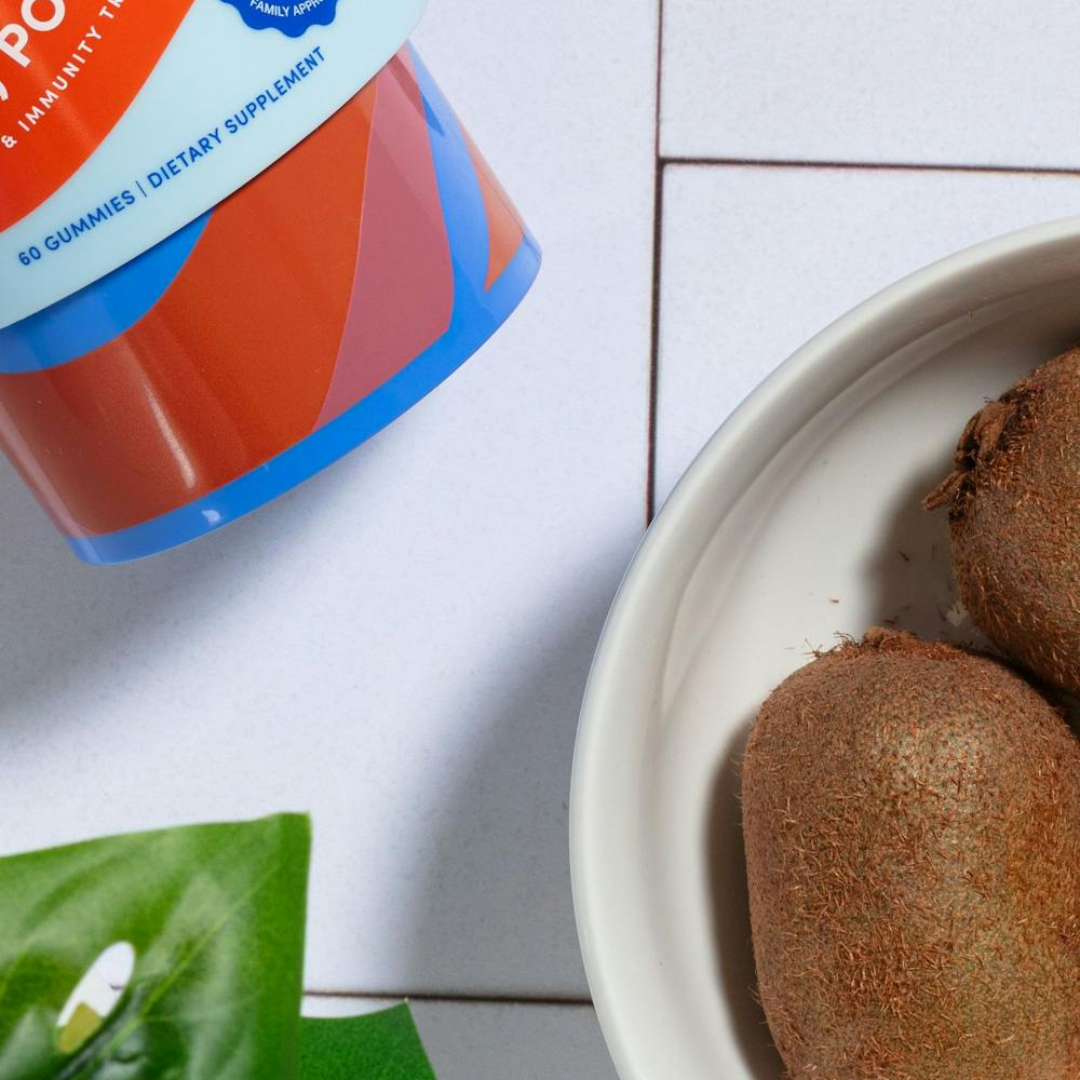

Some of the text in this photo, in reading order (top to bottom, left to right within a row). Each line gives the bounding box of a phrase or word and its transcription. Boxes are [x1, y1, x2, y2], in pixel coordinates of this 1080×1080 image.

[1, 134, 18, 149] &
[17, 26, 103, 132] IMMUNITY
[18, 46, 326, 266] 60 GUMMIES DIETARY SUPPLEMENT
